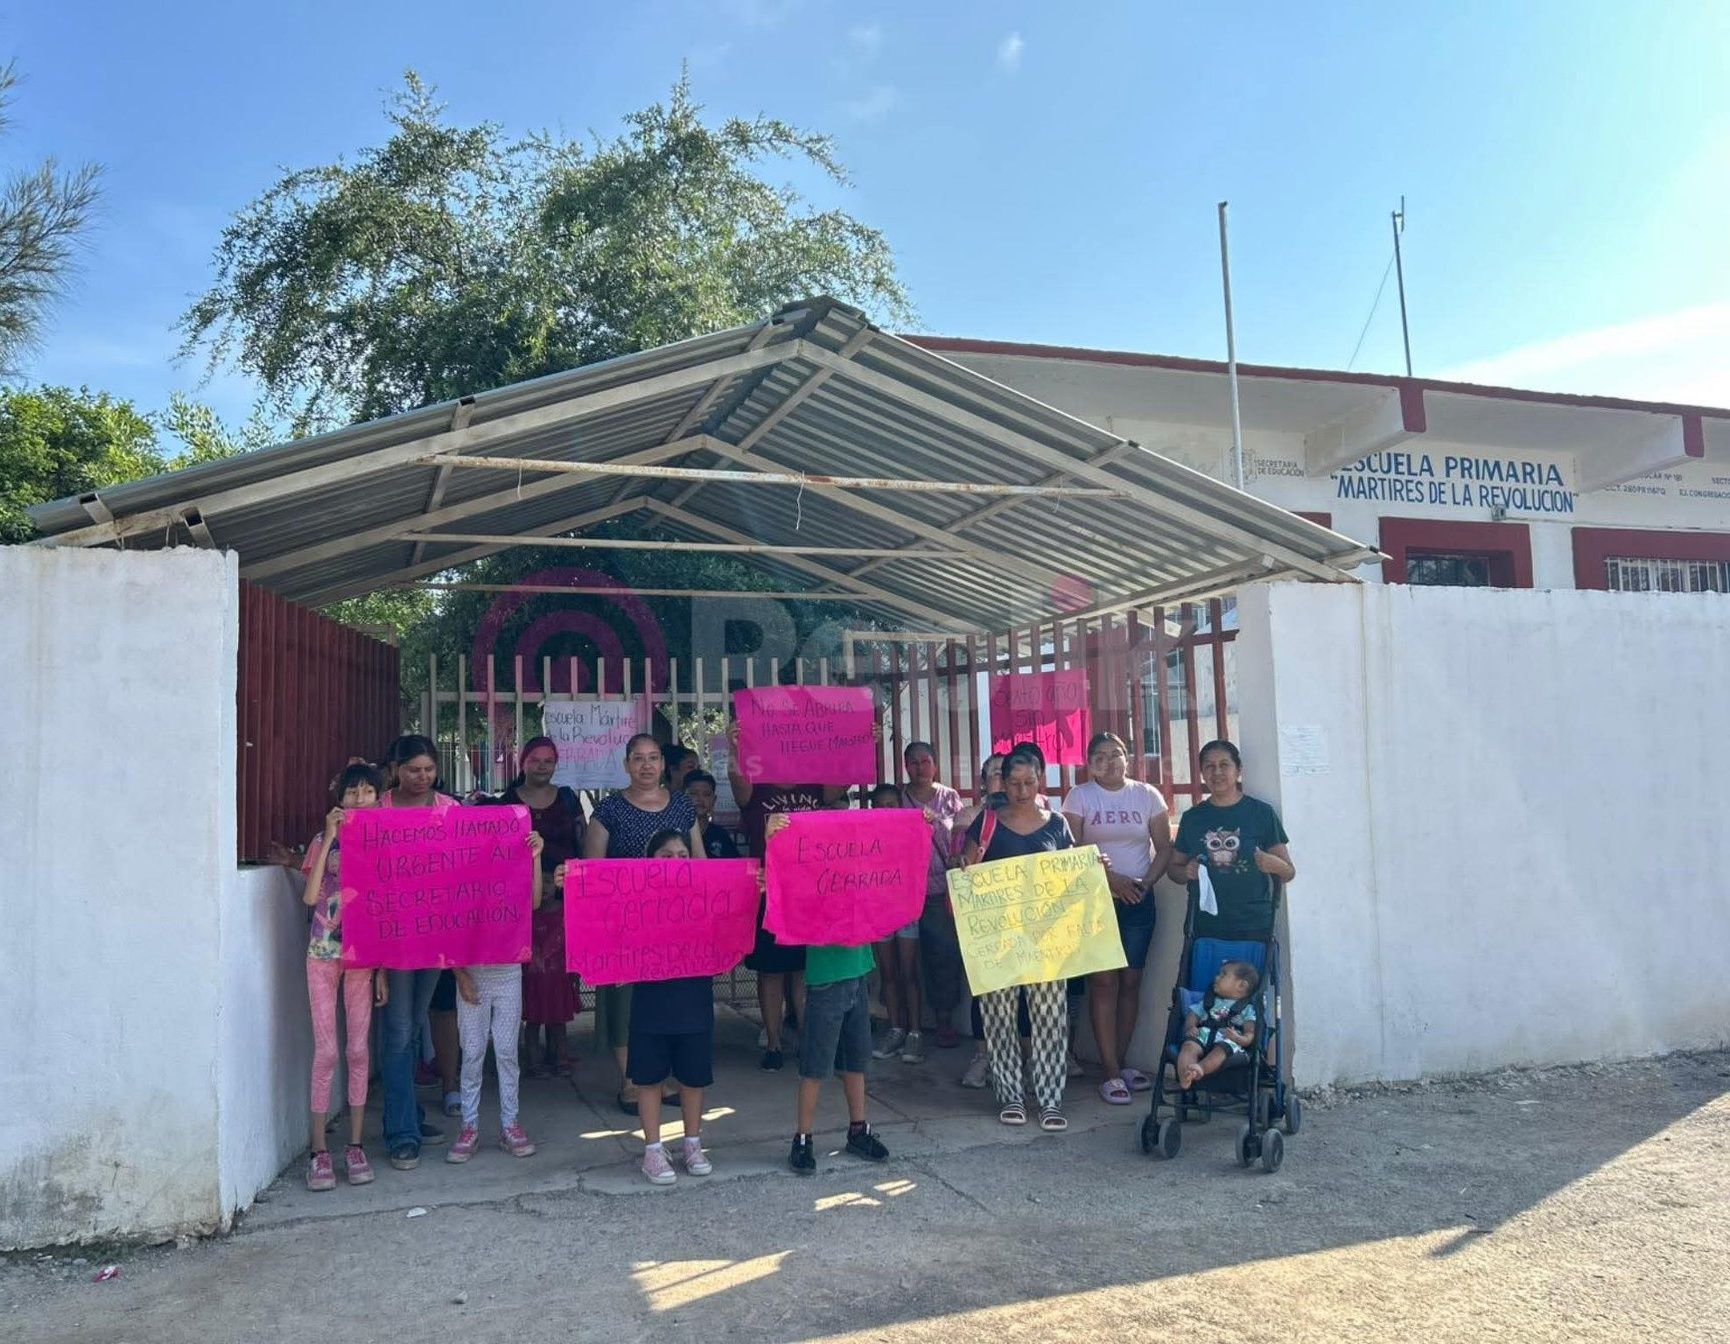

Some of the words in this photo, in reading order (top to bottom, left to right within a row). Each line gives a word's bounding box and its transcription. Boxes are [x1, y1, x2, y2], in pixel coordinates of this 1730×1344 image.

[1446, 457, 1564, 486] PRIMARIA
[1429, 482, 1447, 504] DE
[1452, 484, 1473, 507] LA
[805, 721, 835, 736] QUE
[1090, 810, 1143, 826] AERO
[364, 822, 448, 852] HACEMOS
[376, 846, 482, 884] URGENTE
[950, 863, 1028, 892] ESCUELA
[815, 868, 903, 896] CERRADA
[1033, 881, 1056, 898] DE
[1064, 876, 1090, 894] LA
[366, 878, 508, 917] SECRETARIO
[378, 918, 406, 940] DE
